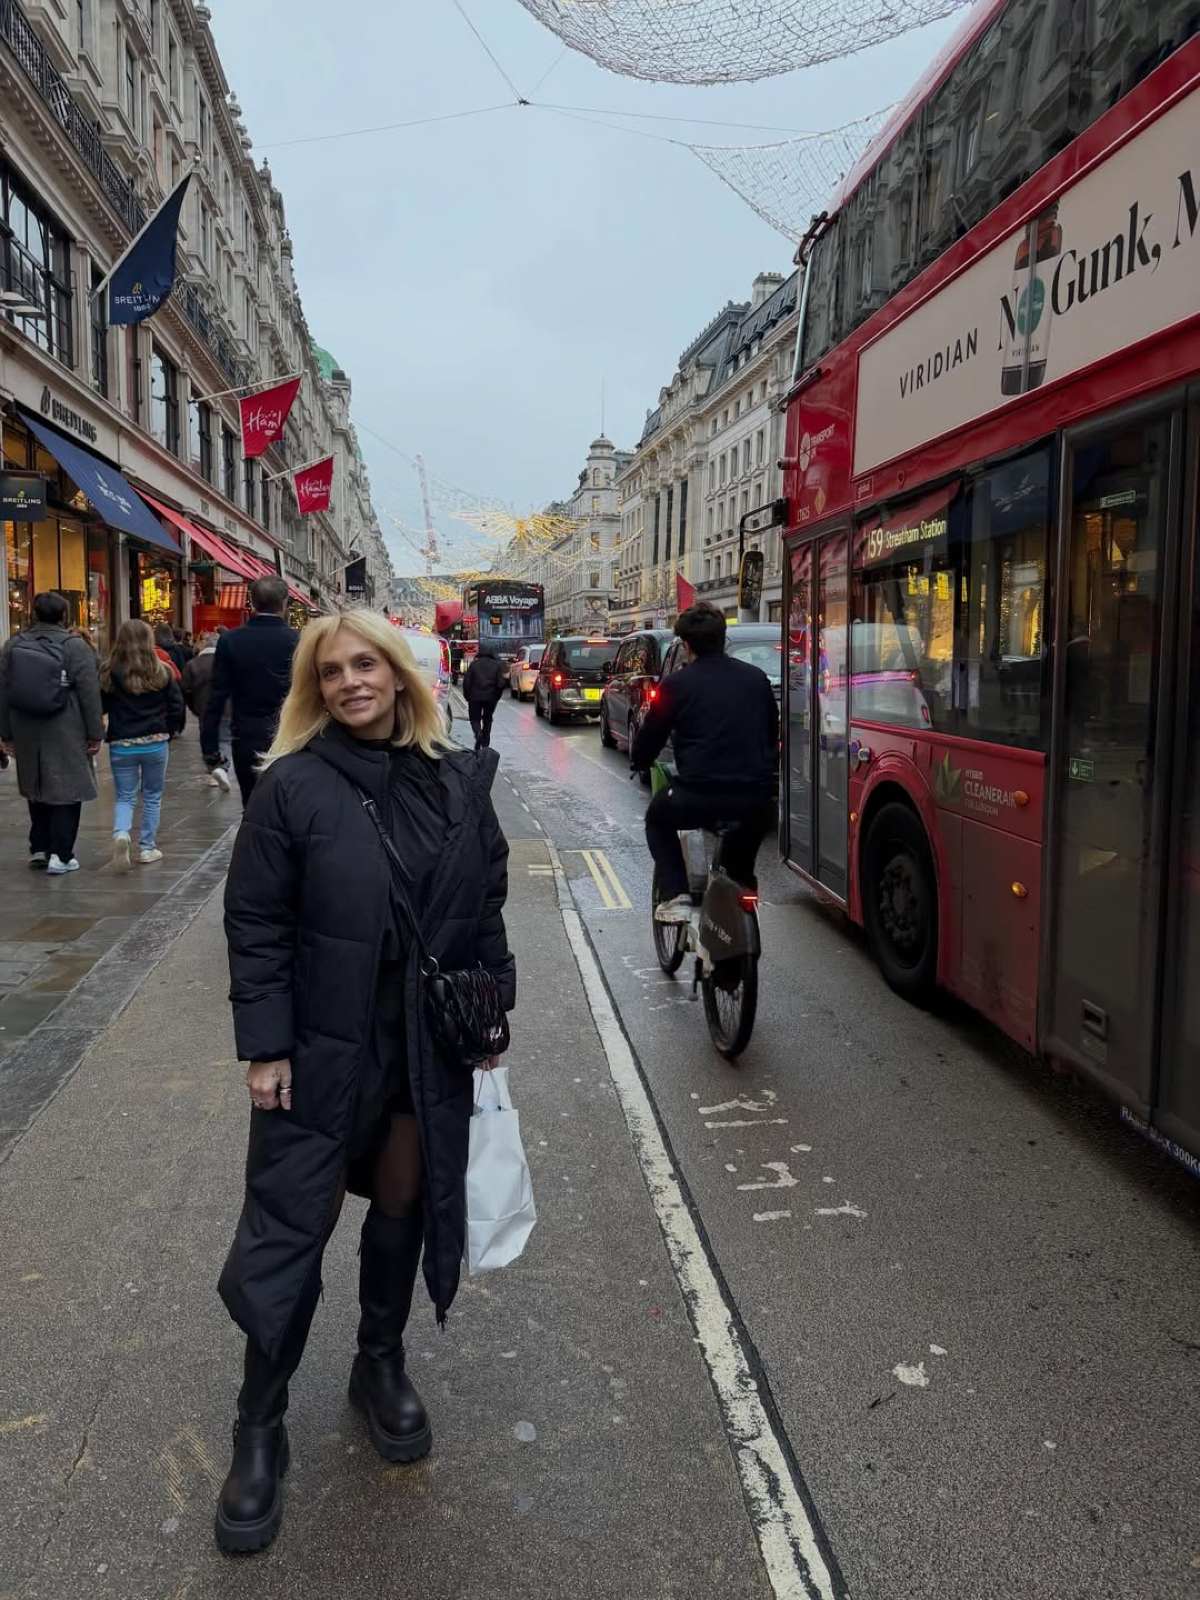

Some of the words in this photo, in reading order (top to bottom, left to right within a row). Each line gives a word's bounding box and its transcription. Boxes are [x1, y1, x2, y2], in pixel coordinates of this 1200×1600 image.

[1051, 201, 1161, 315] Gunk,
[899, 328, 978, 398] VIRIDIAN
[52, 398, 97, 442] BREITLING
[2, 497, 41, 505] BREITLING
[920, 518, 948, 540] Station
[485, 595, 509, 604] ABBA
[509, 595, 539, 608] Voyage
